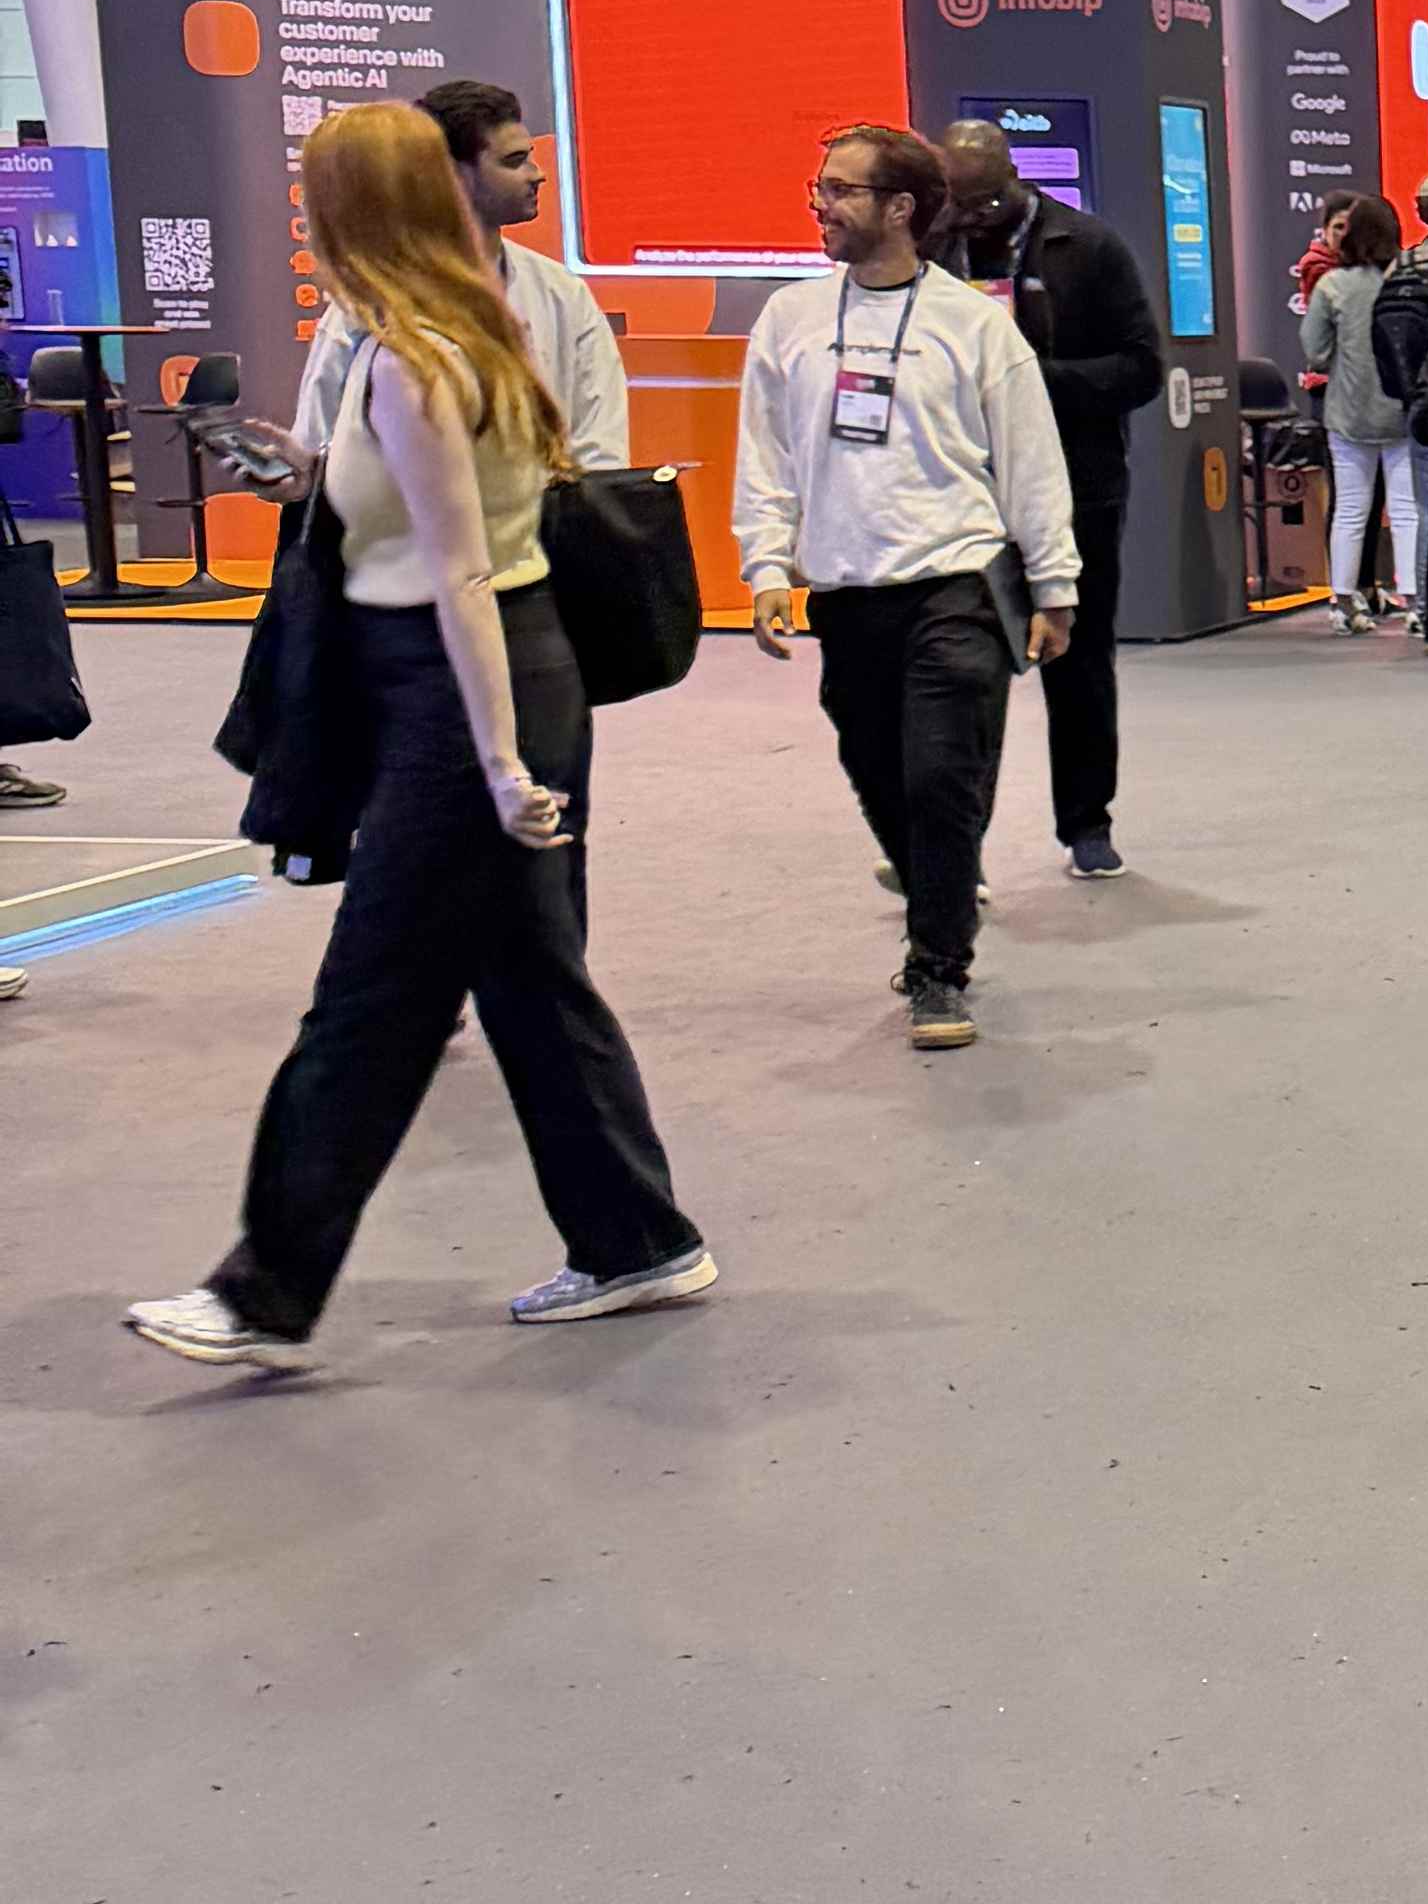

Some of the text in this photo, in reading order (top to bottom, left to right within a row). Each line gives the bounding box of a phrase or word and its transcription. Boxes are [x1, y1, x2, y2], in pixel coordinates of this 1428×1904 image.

[385, 4, 434, 25] your
[278, 22, 382, 43] customer
[280, 45, 445, 68] experience with
[281, 64, 388, 90] Agentic AI
[1291, 92, 1347, 115] Google
[1311, 130, 1351, 145] Meta
